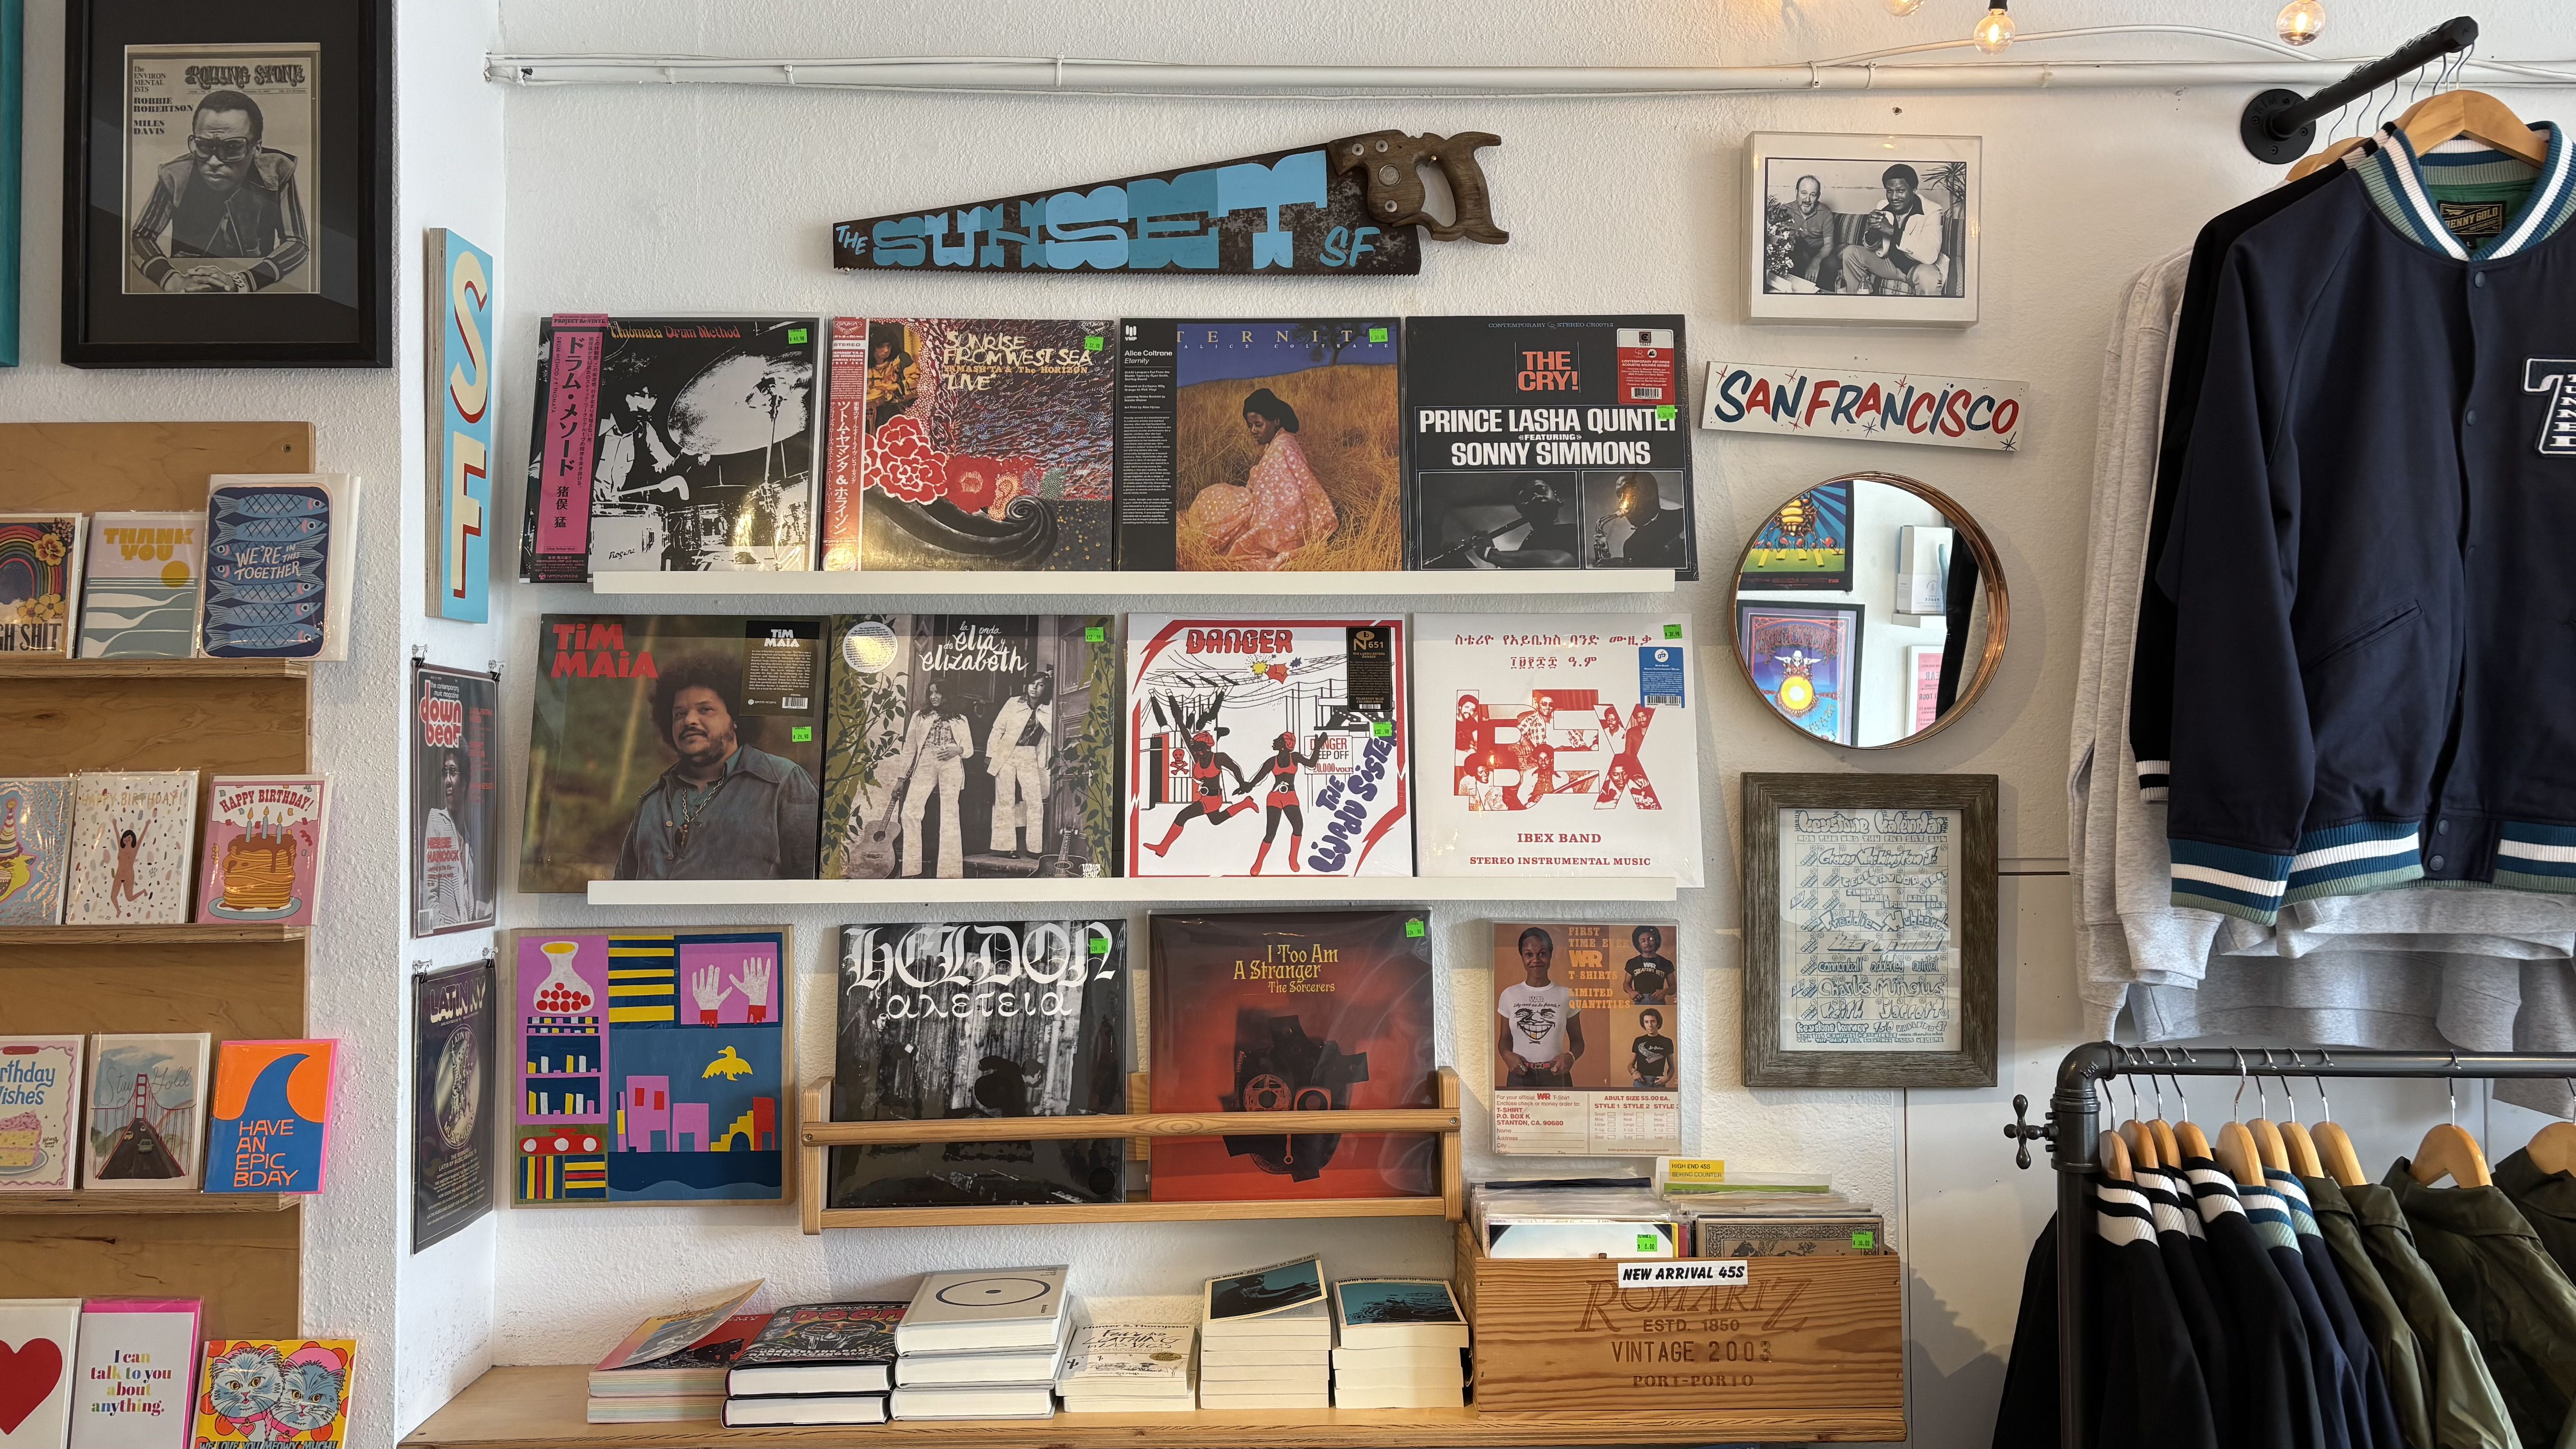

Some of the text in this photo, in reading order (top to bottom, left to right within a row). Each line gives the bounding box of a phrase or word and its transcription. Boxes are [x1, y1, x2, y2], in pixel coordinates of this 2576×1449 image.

[185, 64, 306, 89] ROLLING STONE
[873, 150, 1328, 270] SUNSET
[2476, 207, 2498, 222] GOLD
[835, 225, 867, 256] THE
[1319, 225, 1381, 267] SF
[945, 331, 1027, 353] SUNRISE
[943, 348, 1094, 367] FROM WEST SEA
[1522, 351, 1571, 371] THE
[1040, 366, 1088, 375] HORIZON
[1518, 372, 1579, 391] CRY!
[1715, 370, 2019, 437] SAN FRANCISCO
[1420, 409, 1503, 433] PRINCE
[1509, 408, 1581, 432] LASHA
[554, 336, 585, 528] ドラム・メソード 猪俣 猛
[836, 401, 851, 473] ツトム・ヤマシタ
[1451, 441, 1651, 466] SONNY SIMMONS
[836, 475, 849, 485] &
[833, 487, 849, 535] ホライゾン
[103, 528, 195, 544] THANK
[120, 544, 174, 561] YOU
[235, 544, 296, 568] WE'RE IN
[282, 552, 302, 561] THIS
[234, 563, 302, 581] TOGETHER
[20, 623, 62, 651] SHIT
[1185, 629, 1293, 654] DANGER
[1455, 634, 1494, 646] ስቴሪዮ
[1570, 634, 1600, 646] ባንድ
[1609, 634, 1652, 647] ሙዚቃ
[919, 644, 1030, 674] elizabeth
[420, 680, 462, 723] down
[425, 721, 462, 748] beat
[82, 791, 183, 806] HAPPY BIRTHDAY!
[220, 789, 315, 813] HAPPY BIRTHDAY!
[1795, 810, 1945, 834] keystone kalendar
[1517, 833, 1602, 843] IBEX BAND
[1470, 856, 1651, 866] STEREO INSTRUMENTAL MUSIC
[1569, 927, 1600, 936] FIRST
[1569, 938, 1630, 948] TIME EVER
[1267, 944, 1339, 963] I Too Am
[1569, 950, 1603, 968] WAR
[1233, 960, 1321, 983] A Stranger
[1268, 980, 1335, 993] The Sorcerers
[1569, 988, 1613, 997] LIMITED
[1818, 975, 1945, 997] Charles Mingus
[430, 975, 486, 1023] LATIN NY
[1569, 999, 1631, 1009] QUANTITIES
[239, 1119, 294, 1136] HAVE
[235, 1136, 266, 1153] AN
[235, 1153, 286, 1171] EPIC
[234, 1170, 299, 1187] BDAY
[1623, 1265, 1745, 1280] NEW ARRIVAL 45S
[1573, 1277, 1813, 1334] ROMARIZ
[790, 1309, 907, 1322] DOOM
[1643, 1319, 1740, 1333] ESTD. 1850
[114, 1350, 150, 1364] I can
[1611, 1340, 1773, 1363] VINTAGE 2003
[91, 1365, 172, 1383] talk to you
[1632, 1374, 1755, 1388] PORT-PORTO
[106, 1382, 152, 1396] about
[91, 1399, 165, 1417] anything.
